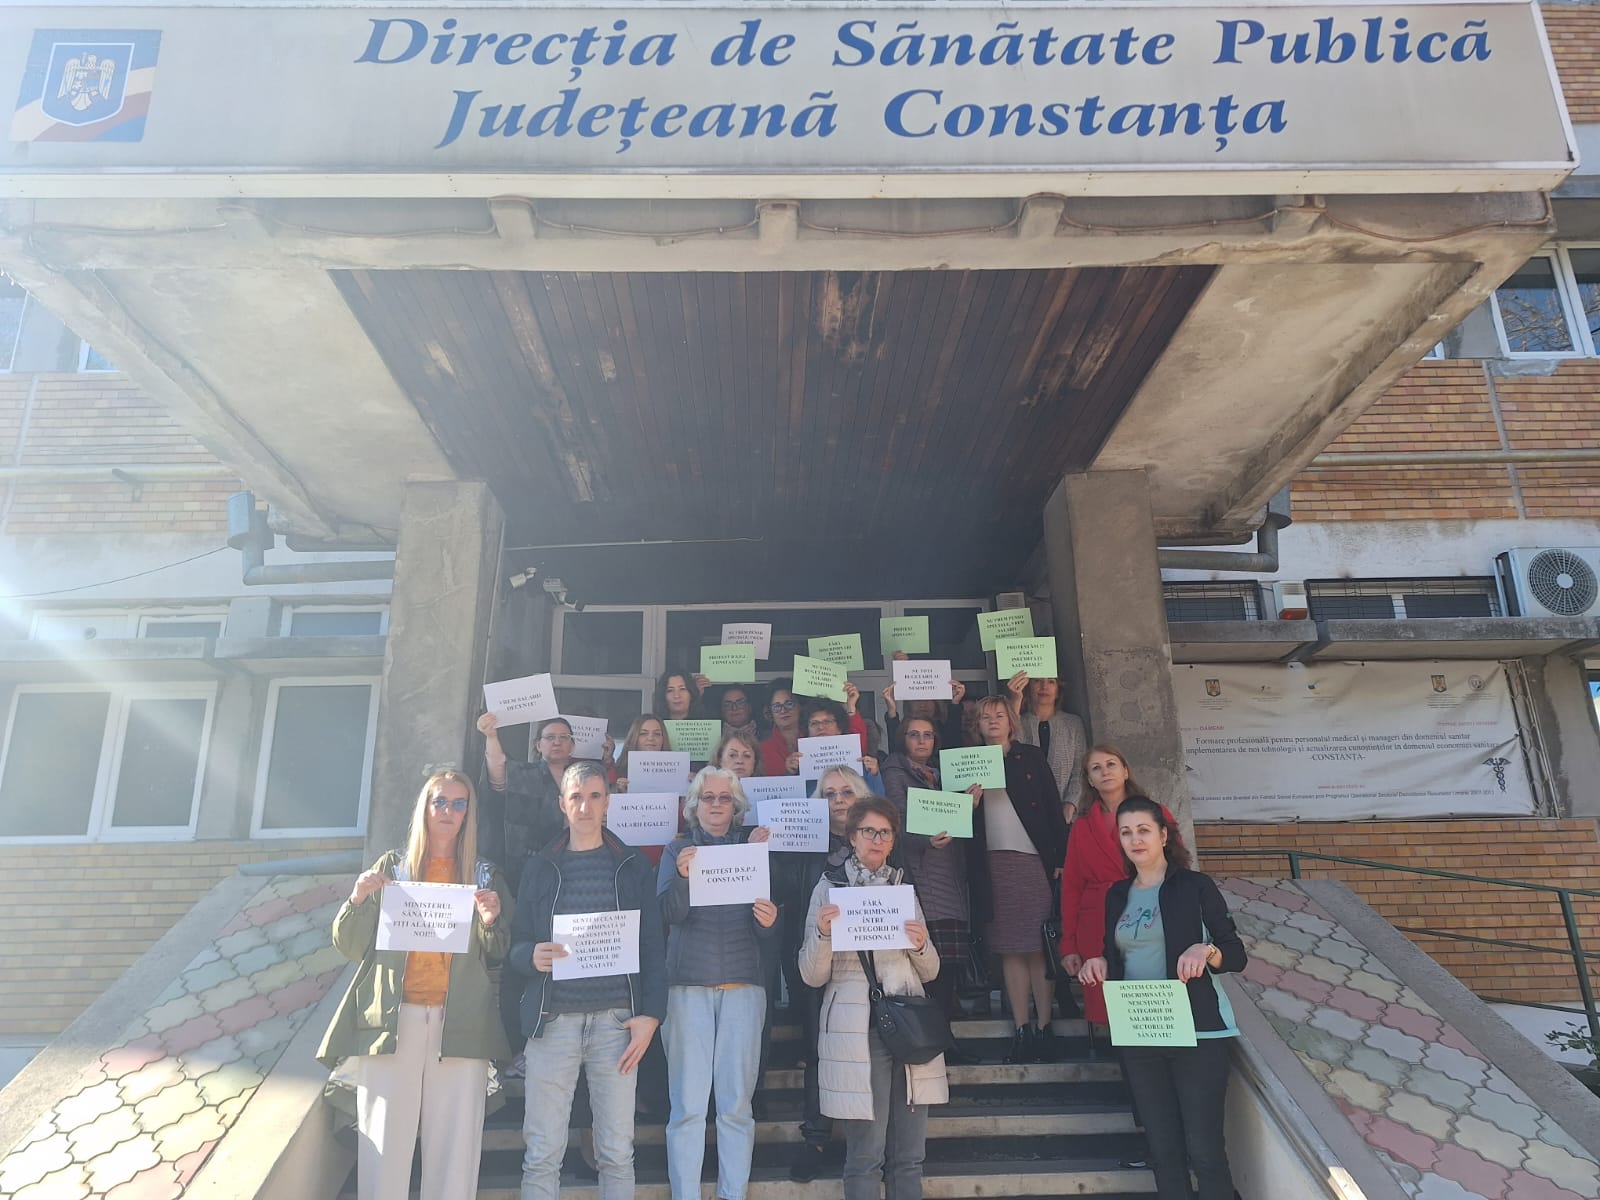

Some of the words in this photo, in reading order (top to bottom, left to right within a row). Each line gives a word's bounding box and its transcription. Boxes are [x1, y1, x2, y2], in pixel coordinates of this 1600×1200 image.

[354, 18, 678, 82] Direcția
[710, 18, 796, 66] de
[884, 88, 1288, 152] Constanța
[1195, 737, 1225, 746] Formare
[1227, 736, 1270, 746] profesională
[1271, 736, 1294, 746] pentru
[1295, 735, 1330, 745] personalul
[1332, 734, 1360, 742] medical
[1368, 734, 1400, 743] manageri
[1402, 733, 1413, 741] din
[1414, 732, 1447, 741] domeniul
[1448, 732, 1471, 740] sanitar
[1262, 745, 1297, 754] tehnologii
[1306, 744, 1347, 752] actualizarea
[1403, 742, 1435, 750] domeniul
[1436, 742, 1472, 750] economiei
[702, 867, 732, 876] PROTEST
[404, 901, 452, 910] MINISTERUL
[862, 899, 882, 907] FĂRĂ
[862, 916, 884, 924] ÎNTRE
[847, 925, 889, 933] CATEGORII
